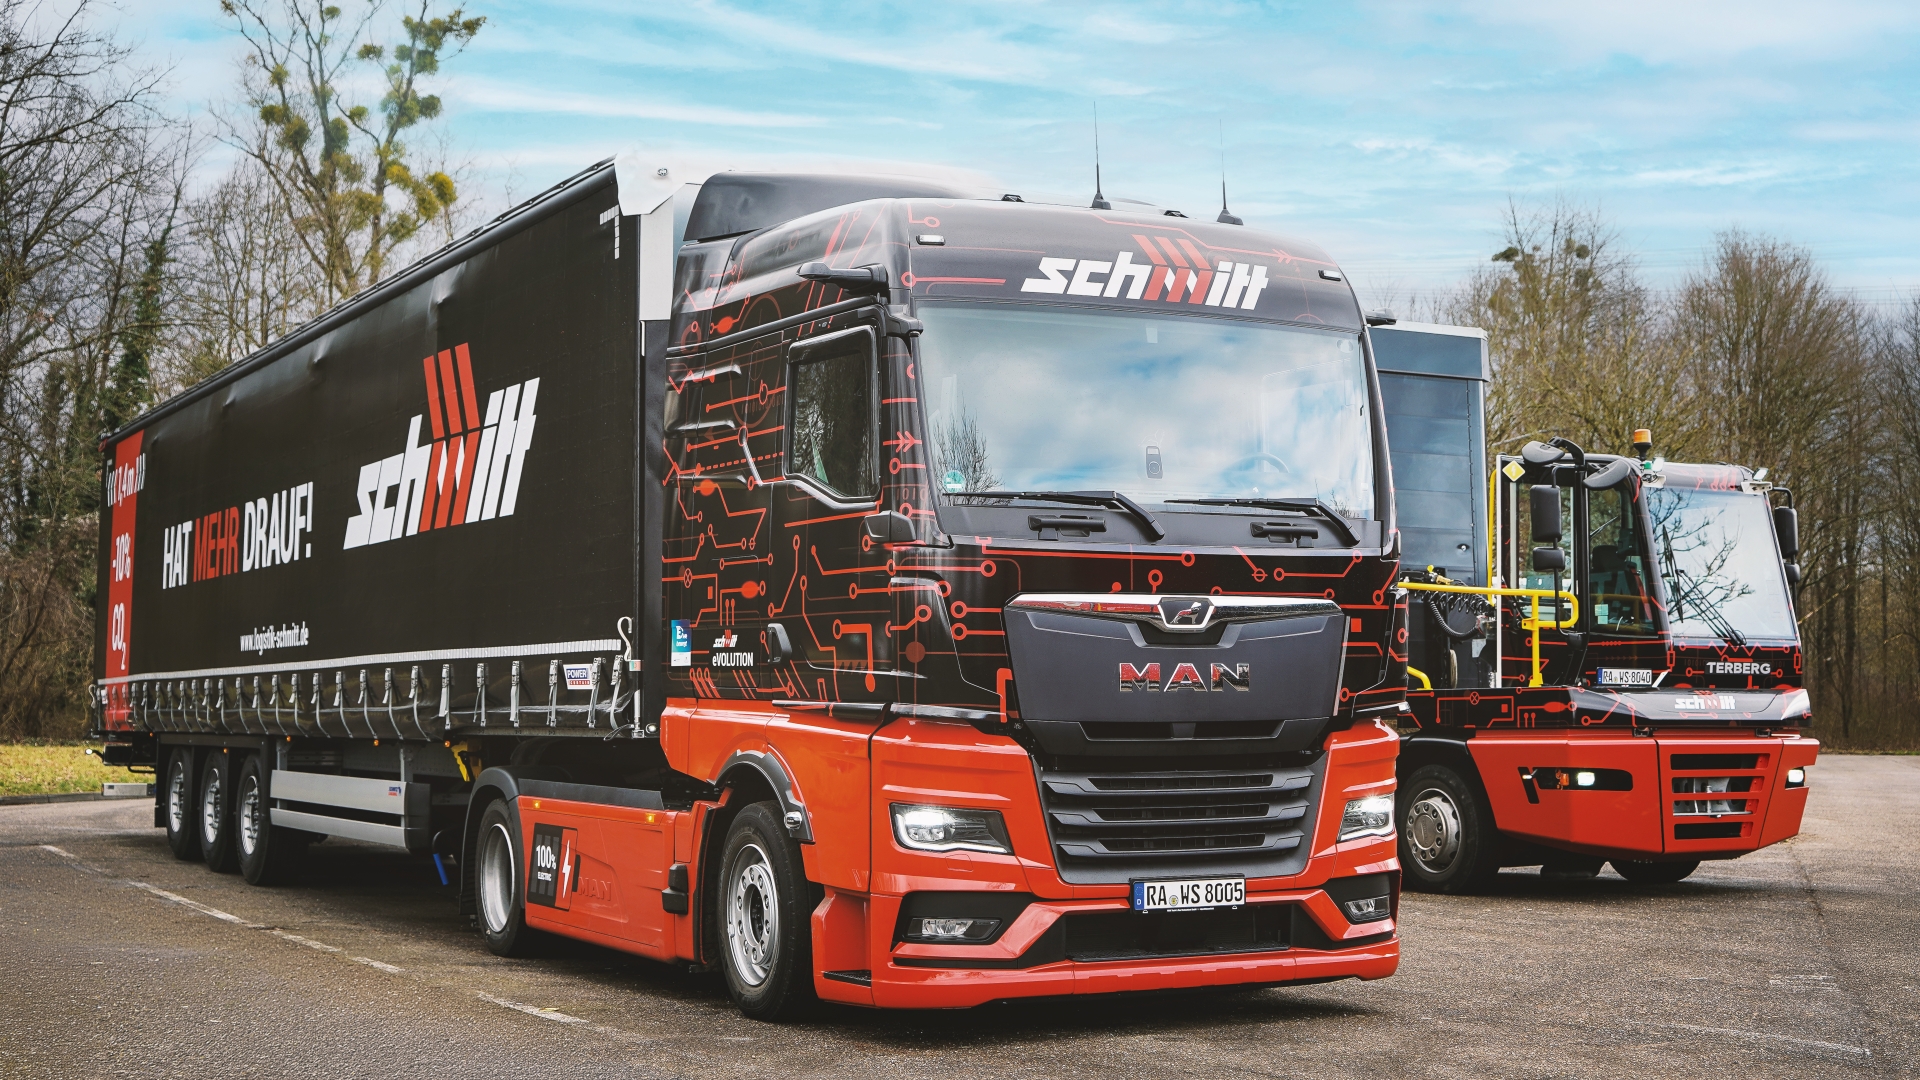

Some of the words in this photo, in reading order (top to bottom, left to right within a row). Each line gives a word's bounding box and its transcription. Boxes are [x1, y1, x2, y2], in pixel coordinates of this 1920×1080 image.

[1020, 234, 1268, 310] schmitt
[343, 342, 540, 550] schmitt
[162, 520, 193, 590] HAT
[193, 506, 239, 582] MEHR
[242, 481, 314, 572] DRAUF!
[112, 532, 131, 582] -10%
[240, 621, 309, 656] www.logistik-schmitt.de
[712, 652, 754, 667] eVOLUTION
[1706, 661, 1771, 675] TERBERG
[567, 669, 587, 679] POWER
[1119, 662, 1250, 692] MAN
[1603, 671, 1613, 683] RA
[1674, 690, 1736, 710] schmitt
[536, 844, 557, 870] 100%
[579, 877, 612, 901] MAN
[1146, 885, 1167, 906] RA
[1180, 883, 1200, 905] WS
[1205, 881, 1243, 903] 8005
